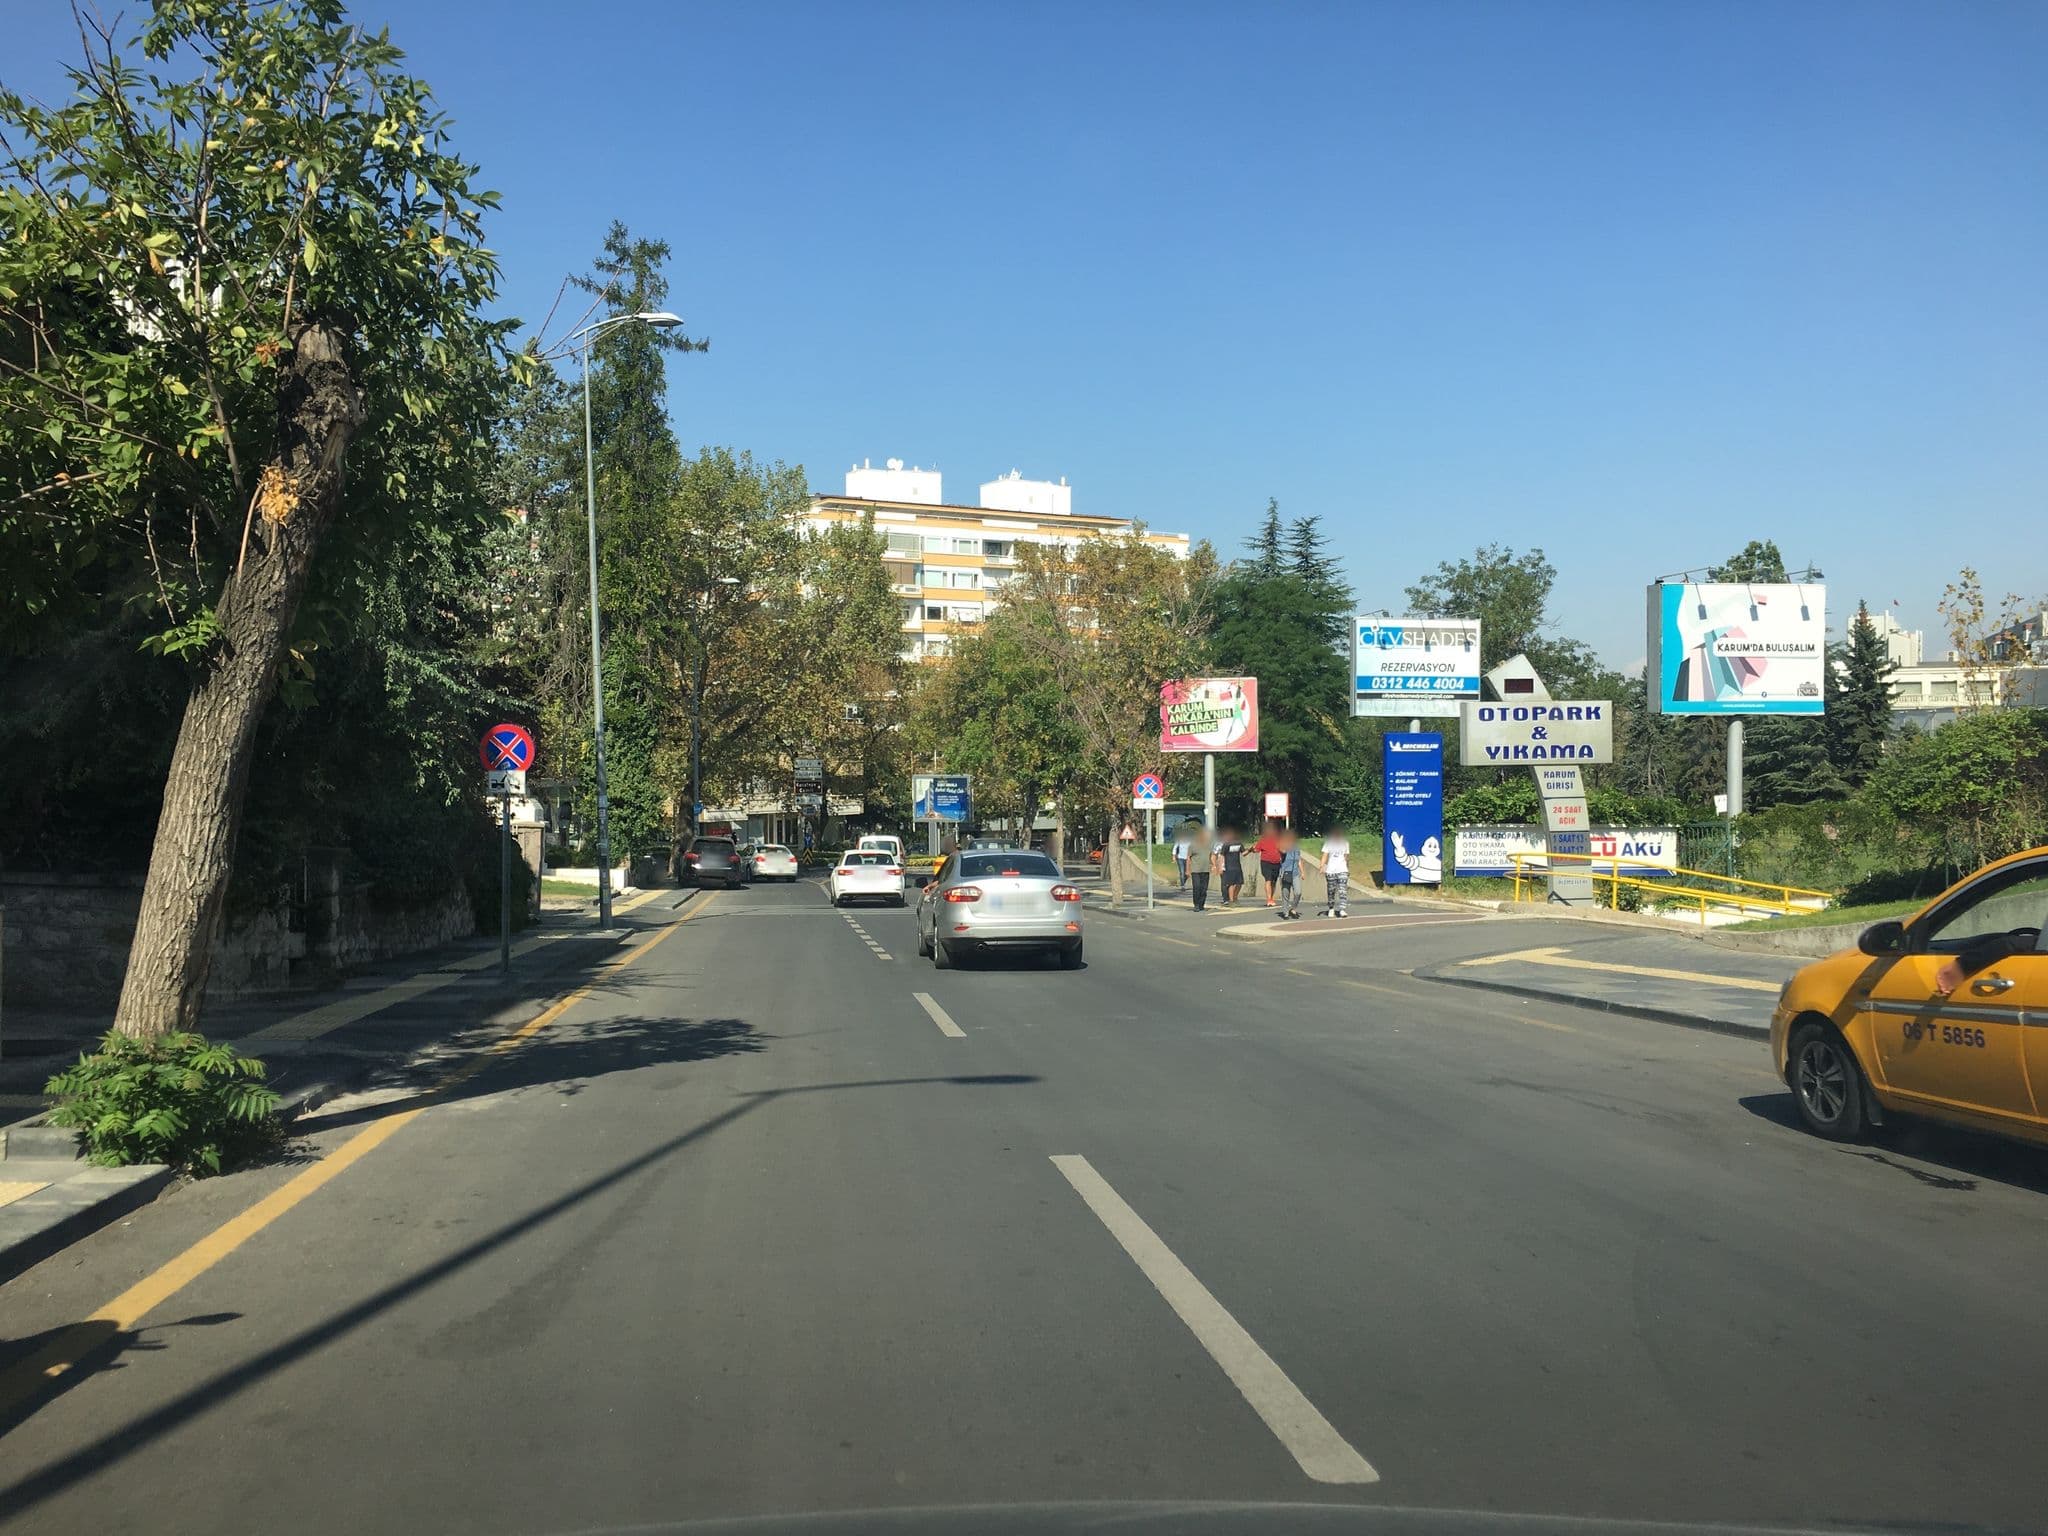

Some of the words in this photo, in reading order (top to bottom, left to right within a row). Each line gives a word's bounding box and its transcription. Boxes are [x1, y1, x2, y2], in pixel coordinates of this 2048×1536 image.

[1717, 643, 1764, 652] KARUM'DA
[1765, 643, 1816, 654] BULUŞALIM
[1380, 662, 1456, 673] REZERVASYON
[1371, 677, 1403, 690] 0312
[1406, 678, 1430, 690] 446
[1432, 679, 1465, 690] 4004
[1167, 701, 1204, 715] KARUM
[1478, 706, 1601, 721] OTOPARK
[1531, 726, 1548, 740] &
[1485, 745, 1594, 760] YIKAMA
[1543, 771, 1576, 779] KARUM
[1462, 841, 1478, 849] OTO
[1558, 834, 1576, 843] SAAT
[1621, 842, 1662, 857] AKÜ
[1903, 1022, 1923, 1041] 06
[1927, 1023, 1937, 1041] T
[1943, 1025, 1986, 1048] 5856
